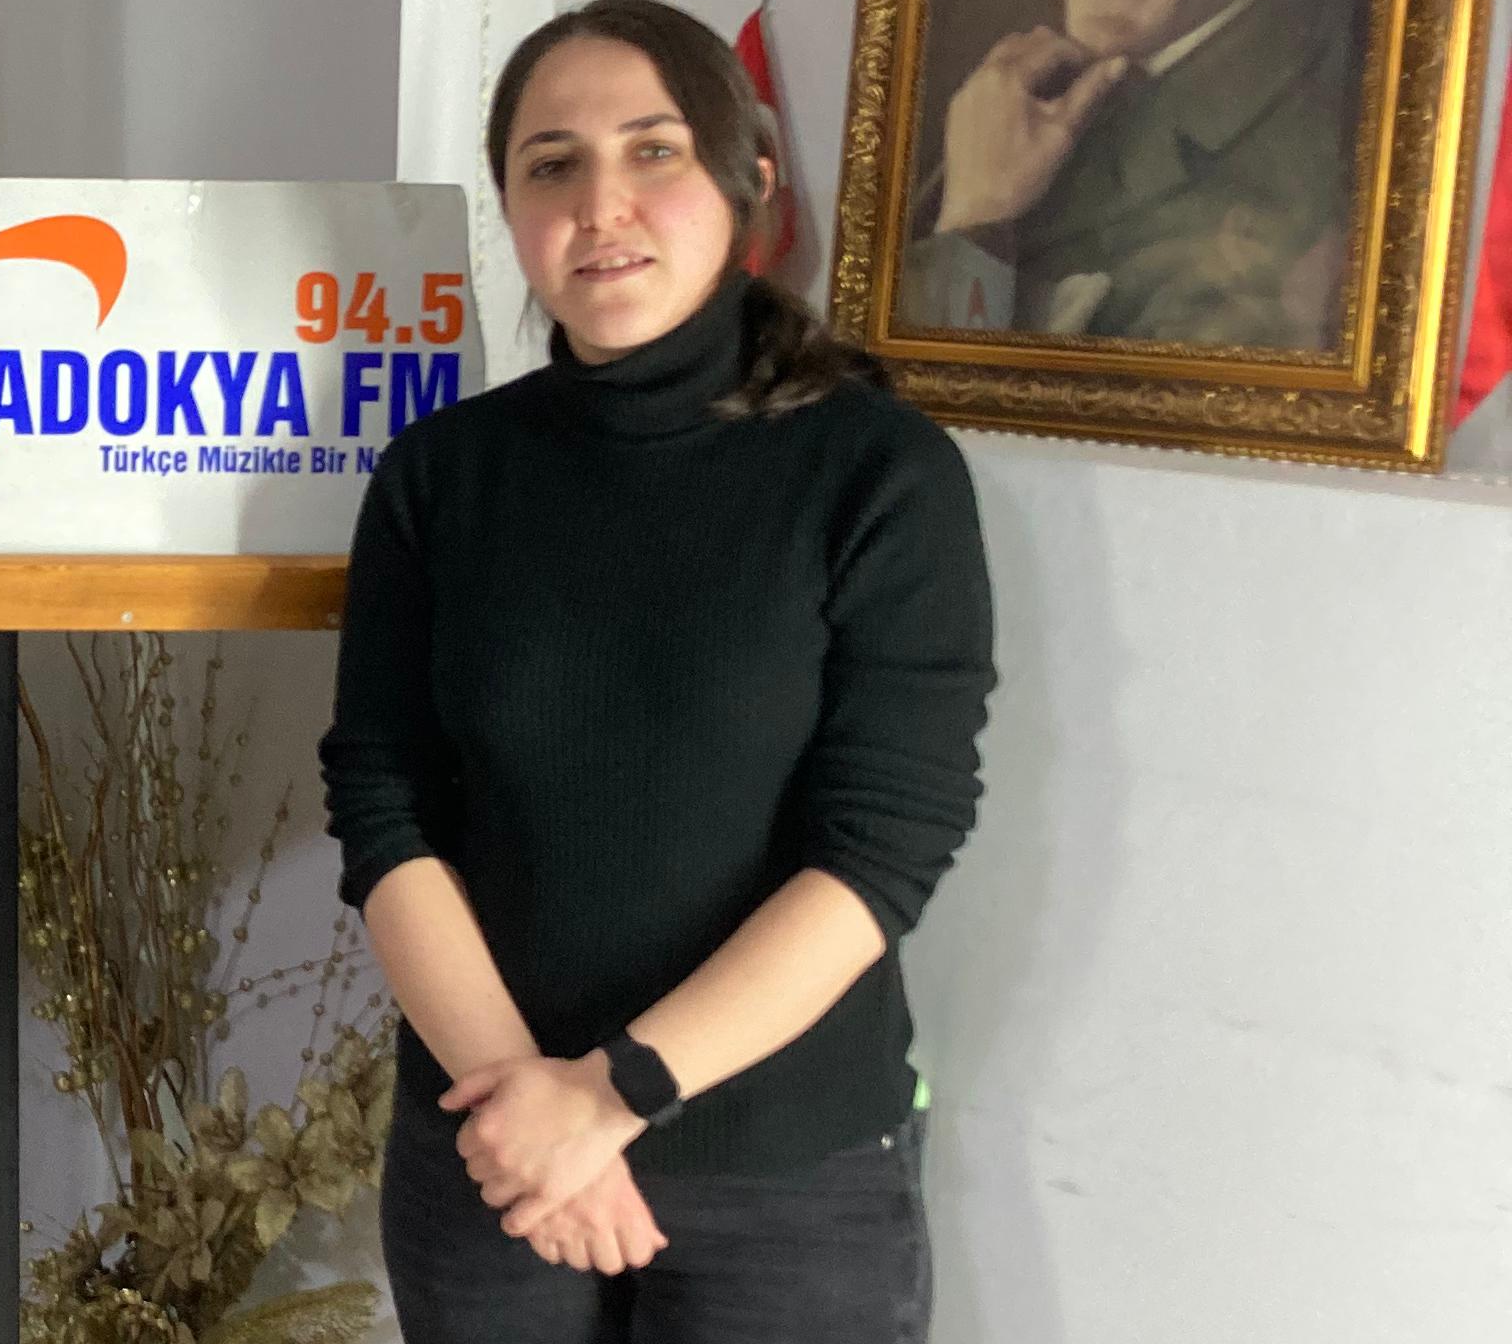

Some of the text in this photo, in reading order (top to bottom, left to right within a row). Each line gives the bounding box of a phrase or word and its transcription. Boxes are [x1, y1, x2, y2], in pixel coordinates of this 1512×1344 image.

[295, 272, 463, 344] 94.5
[342, 352, 460, 436] FM
[99, 445, 187, 476] Türkçe
[198, 445, 300, 473] Müzikte
[311, 446, 345, 473] Bir
